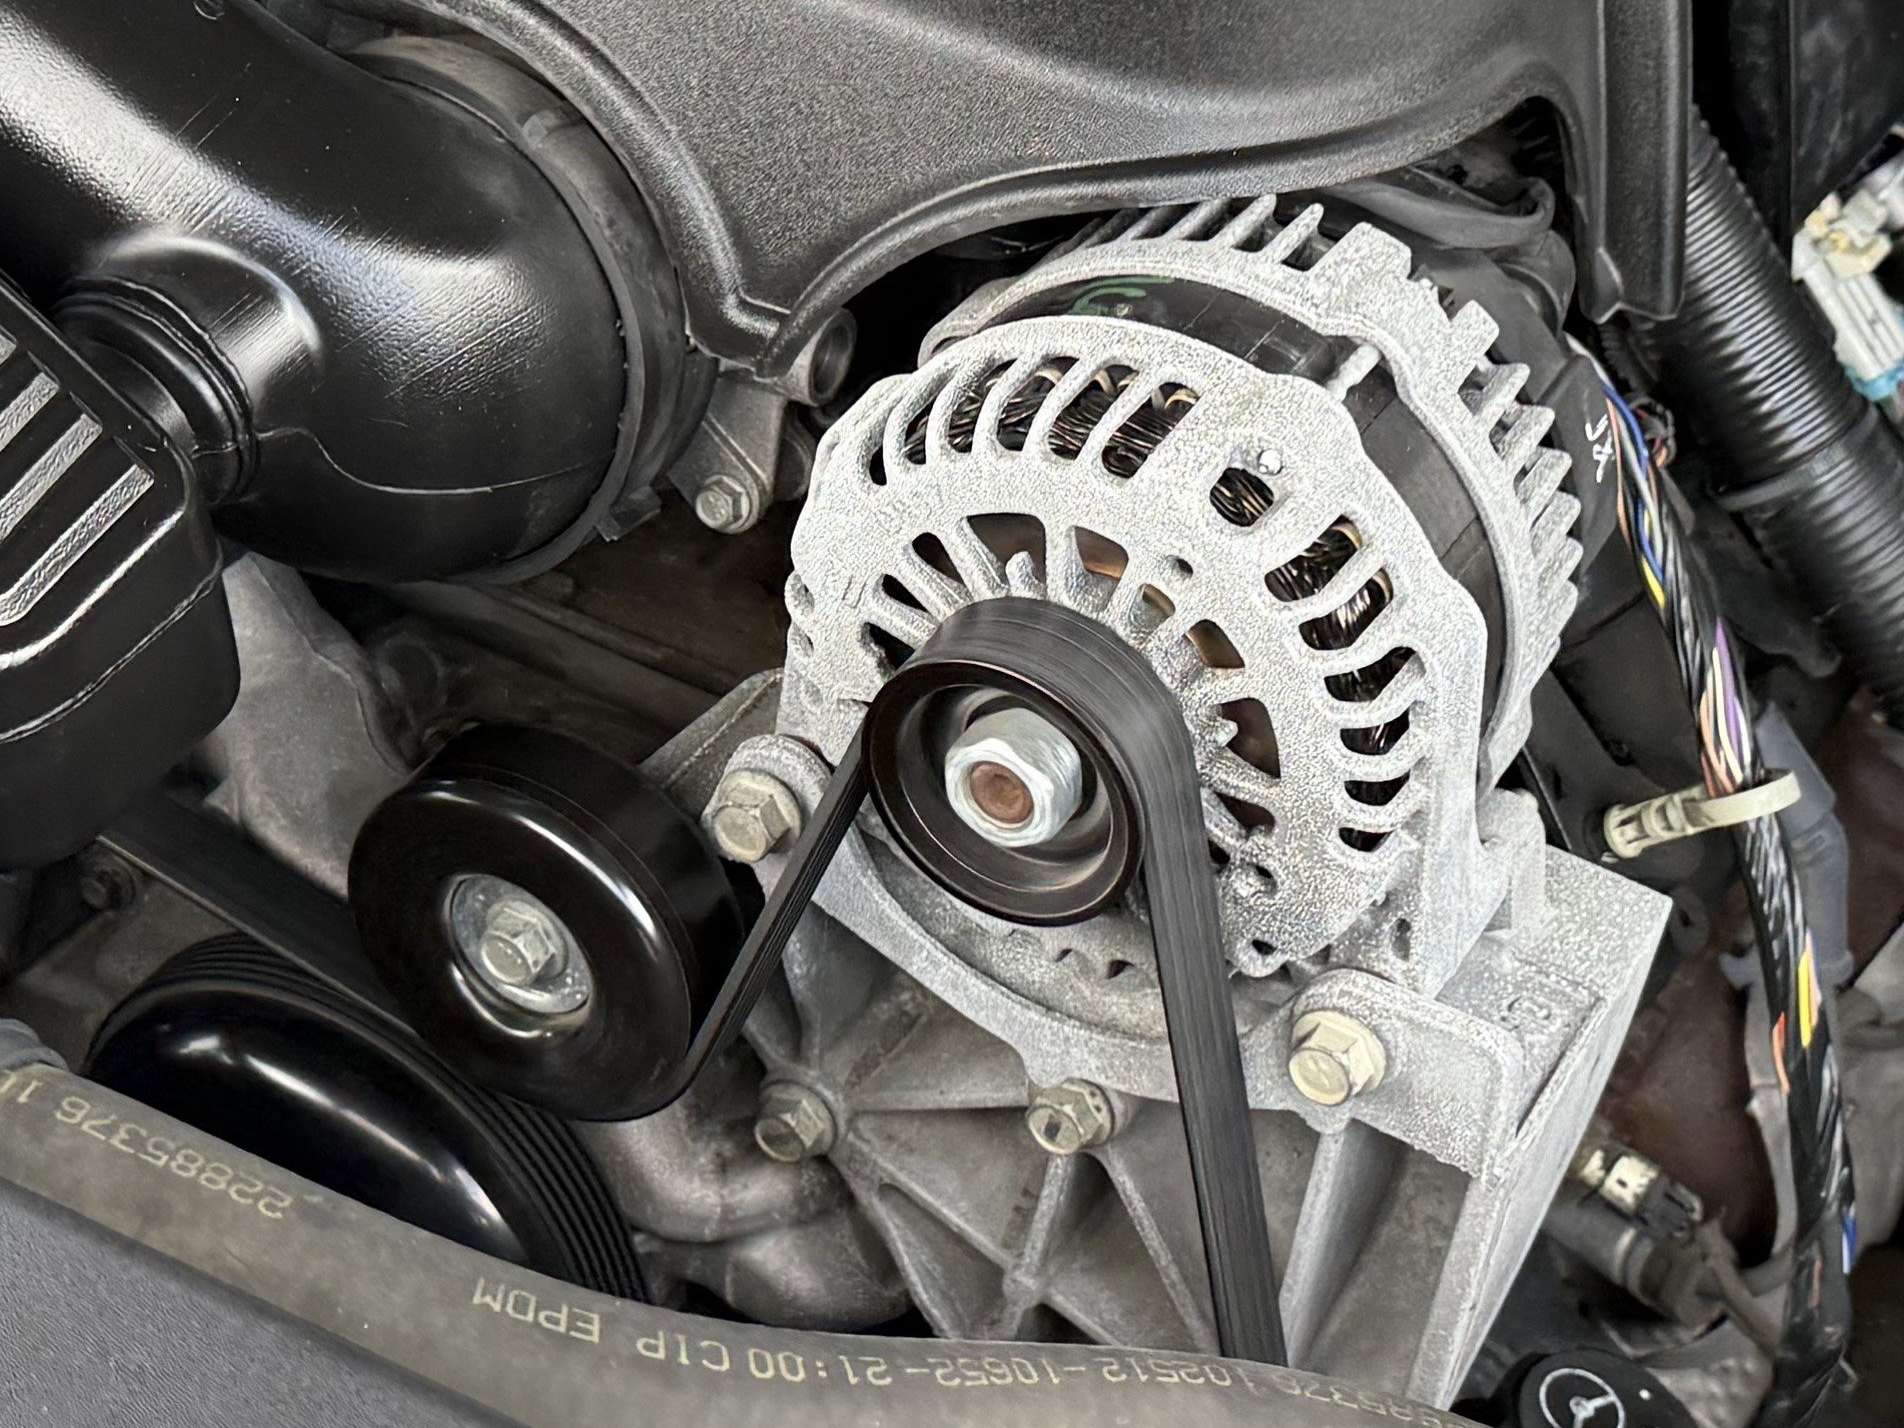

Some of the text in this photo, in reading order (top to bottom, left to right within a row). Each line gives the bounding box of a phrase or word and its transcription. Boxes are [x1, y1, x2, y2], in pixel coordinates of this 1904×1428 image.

[50, 1092, 295, 1222] 22885376
[471, 1275, 604, 1344] EPDM
[633, 1329, 731, 1373] CIP
